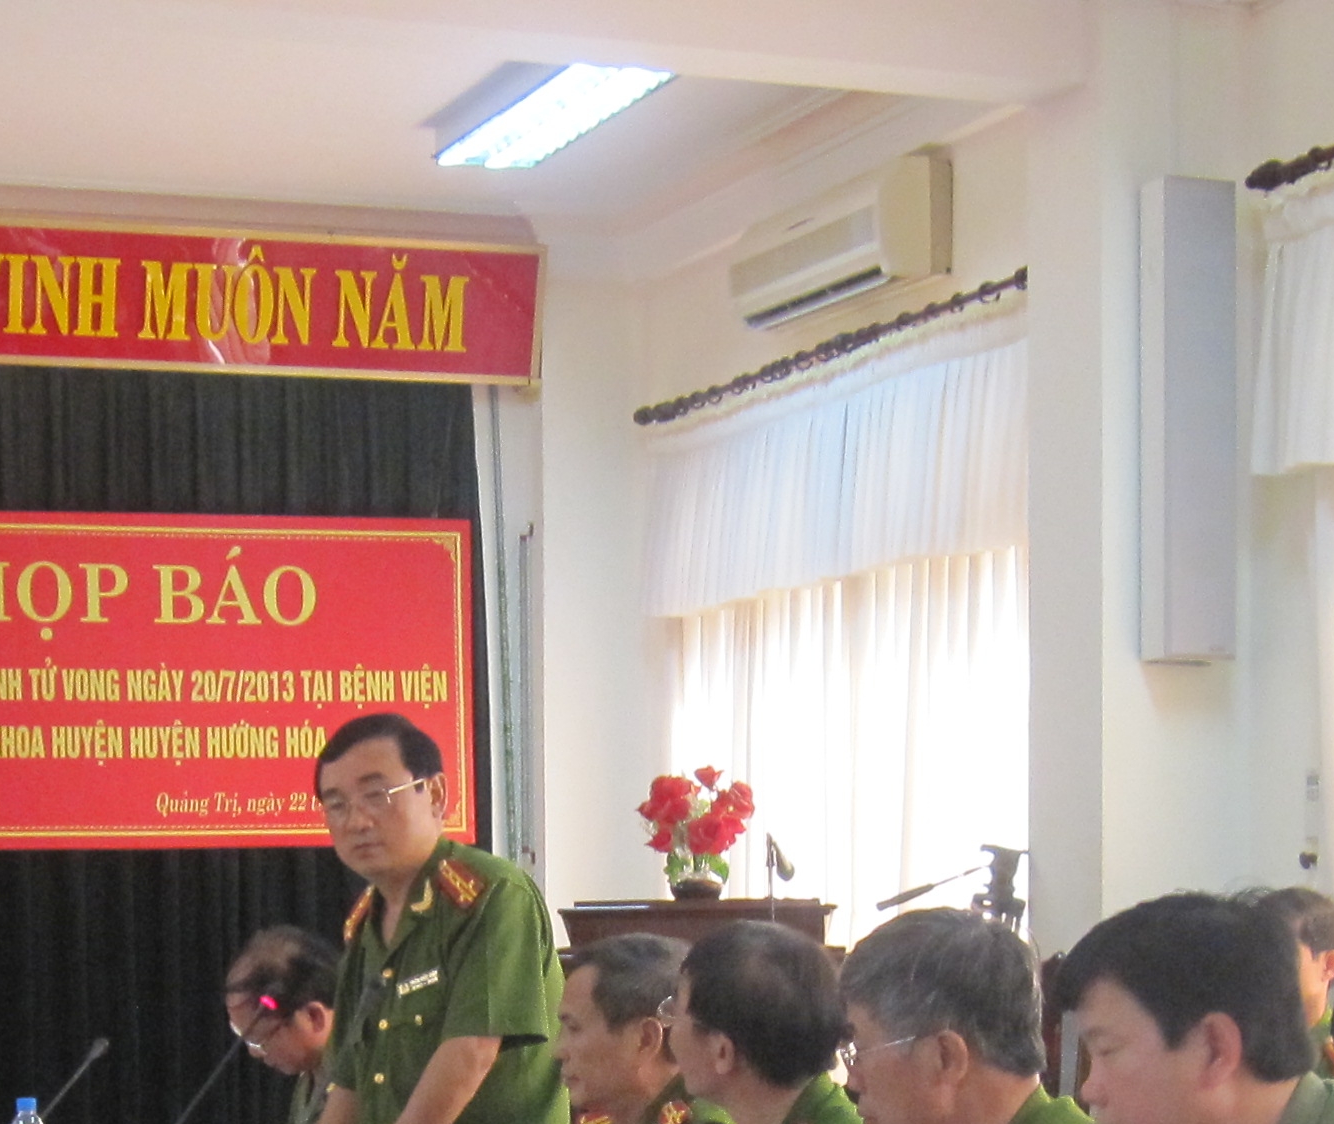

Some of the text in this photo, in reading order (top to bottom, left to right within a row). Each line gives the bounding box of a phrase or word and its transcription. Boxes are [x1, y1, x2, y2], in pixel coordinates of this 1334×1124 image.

[138, 246, 315, 346] MUÔN
[332, 254, 468, 352] NĂM
[153, 547, 318, 626] BÁO
[62, 668, 120, 702] VONG
[126, 663, 185, 702] NGÀY
[191, 669, 295, 703] 20/7/2013
[300, 669, 333, 709] TẠI
[339, 663, 396, 709] BỆNH
[401, 663, 448, 709] VIỆN
[51, 720, 123, 767] HUYỆN
[129, 721, 202, 765] HUYỆN
[207, 720, 280, 759] HƯỚNG
[156, 790, 209, 817] Quảng
[247, 792, 285, 816] ngày
[288, 792, 307, 811] 22
